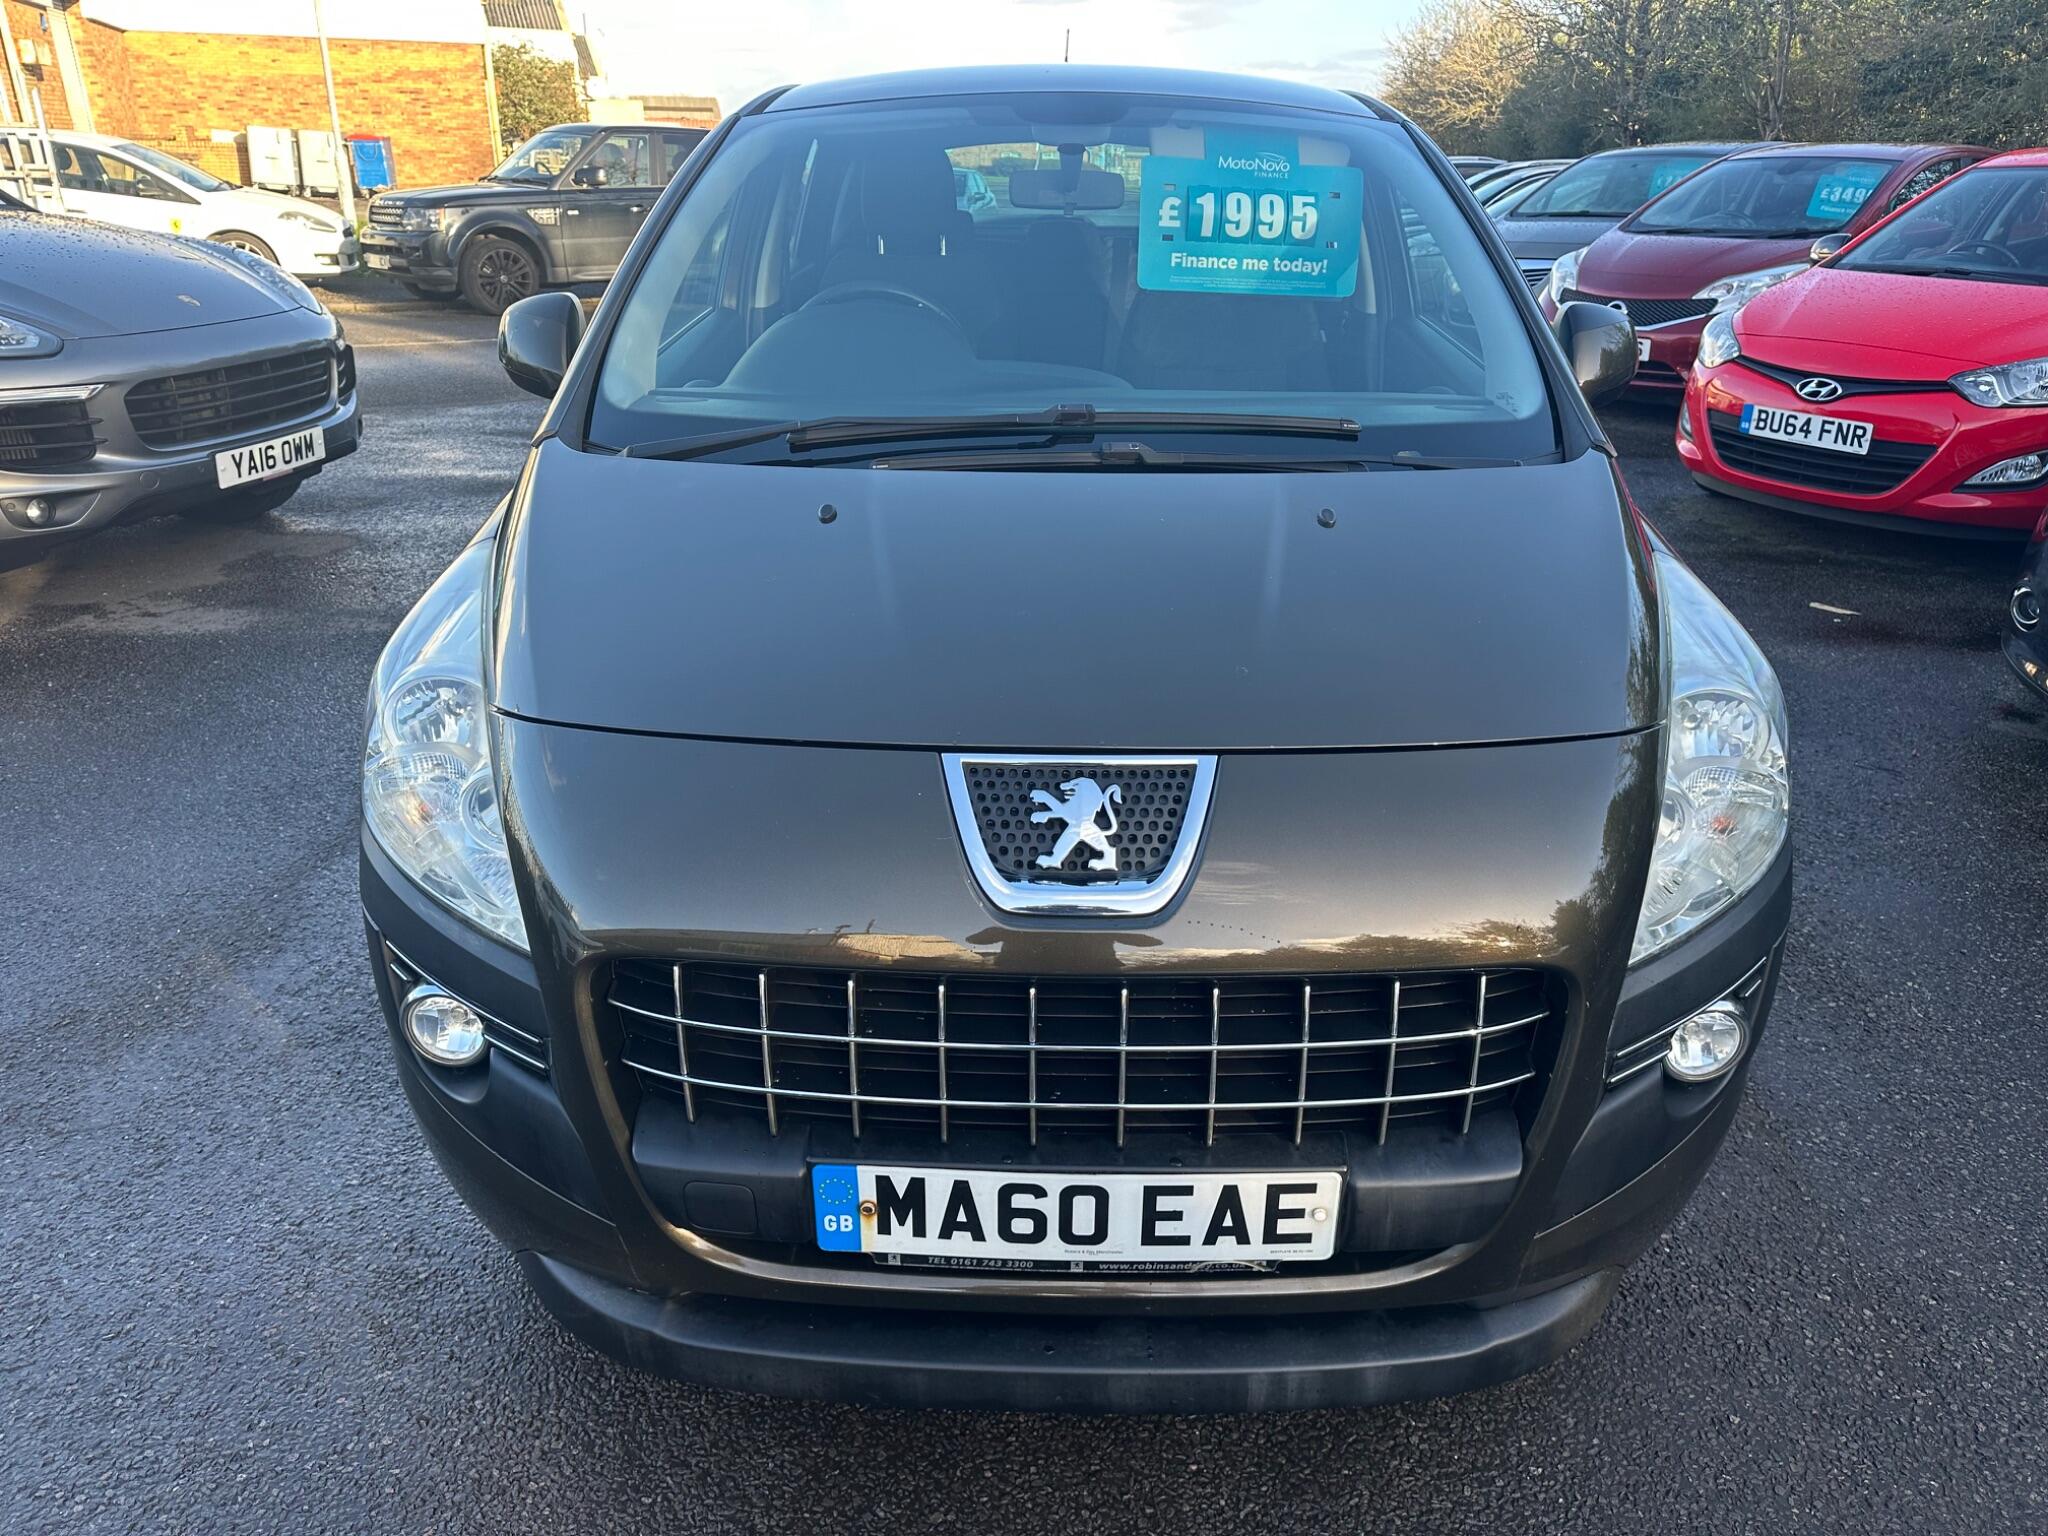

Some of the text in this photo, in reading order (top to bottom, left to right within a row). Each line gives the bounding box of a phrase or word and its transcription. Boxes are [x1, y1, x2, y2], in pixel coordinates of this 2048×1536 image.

[1218, 155, 1290, 172] MotoNovo
[1254, 171, 1289, 179] FINANCE
[1171, 252, 1328, 276] Finance me today!
[1755, 409, 1867, 448] BU64 FNR
[231, 433, 315, 478] YA16 OWM
[875, 1174, 1318, 1246] MA60 EAE
[824, 1215, 853, 1232] GB
[928, 1256, 1034, 1268] TEL 0161 743 3300
